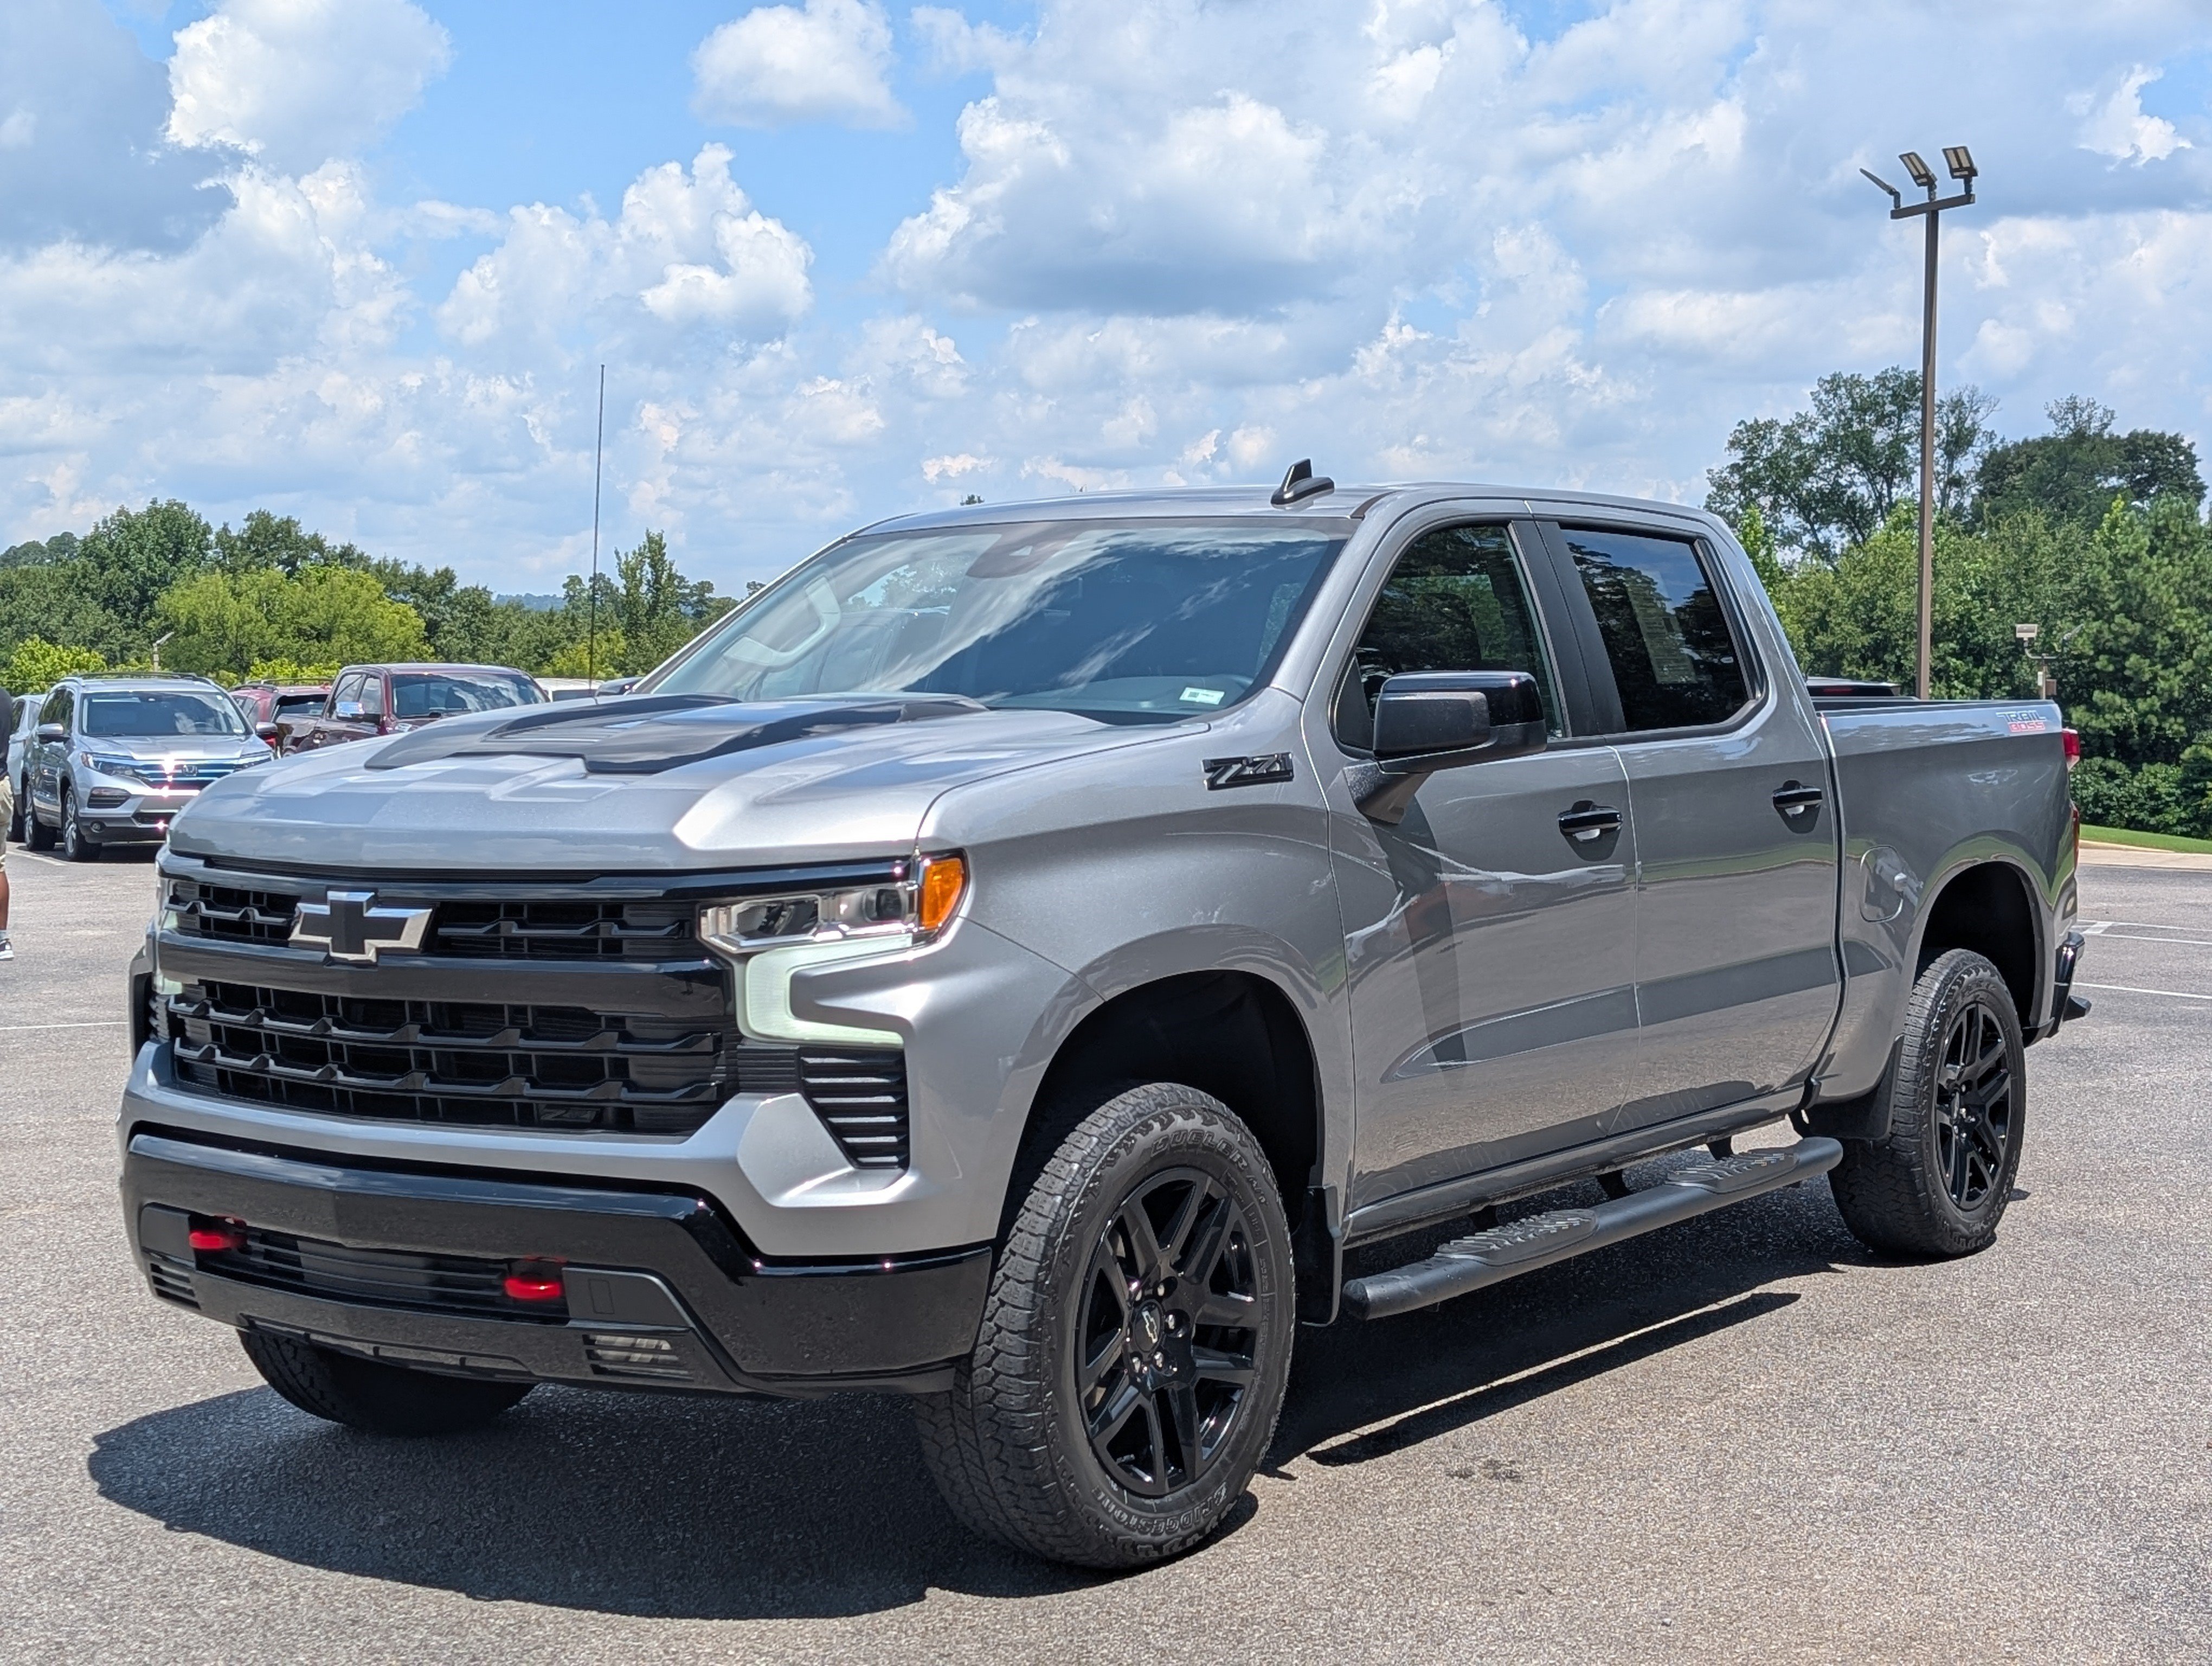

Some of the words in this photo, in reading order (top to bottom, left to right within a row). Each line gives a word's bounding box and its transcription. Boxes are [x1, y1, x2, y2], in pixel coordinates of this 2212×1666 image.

[1996, 710, 2046, 722] TRAIL
[2008, 722, 2046, 732] BOSS
[1202, 752, 1294, 790] Z71
[1150, 1129, 1248, 1170] DUELER
